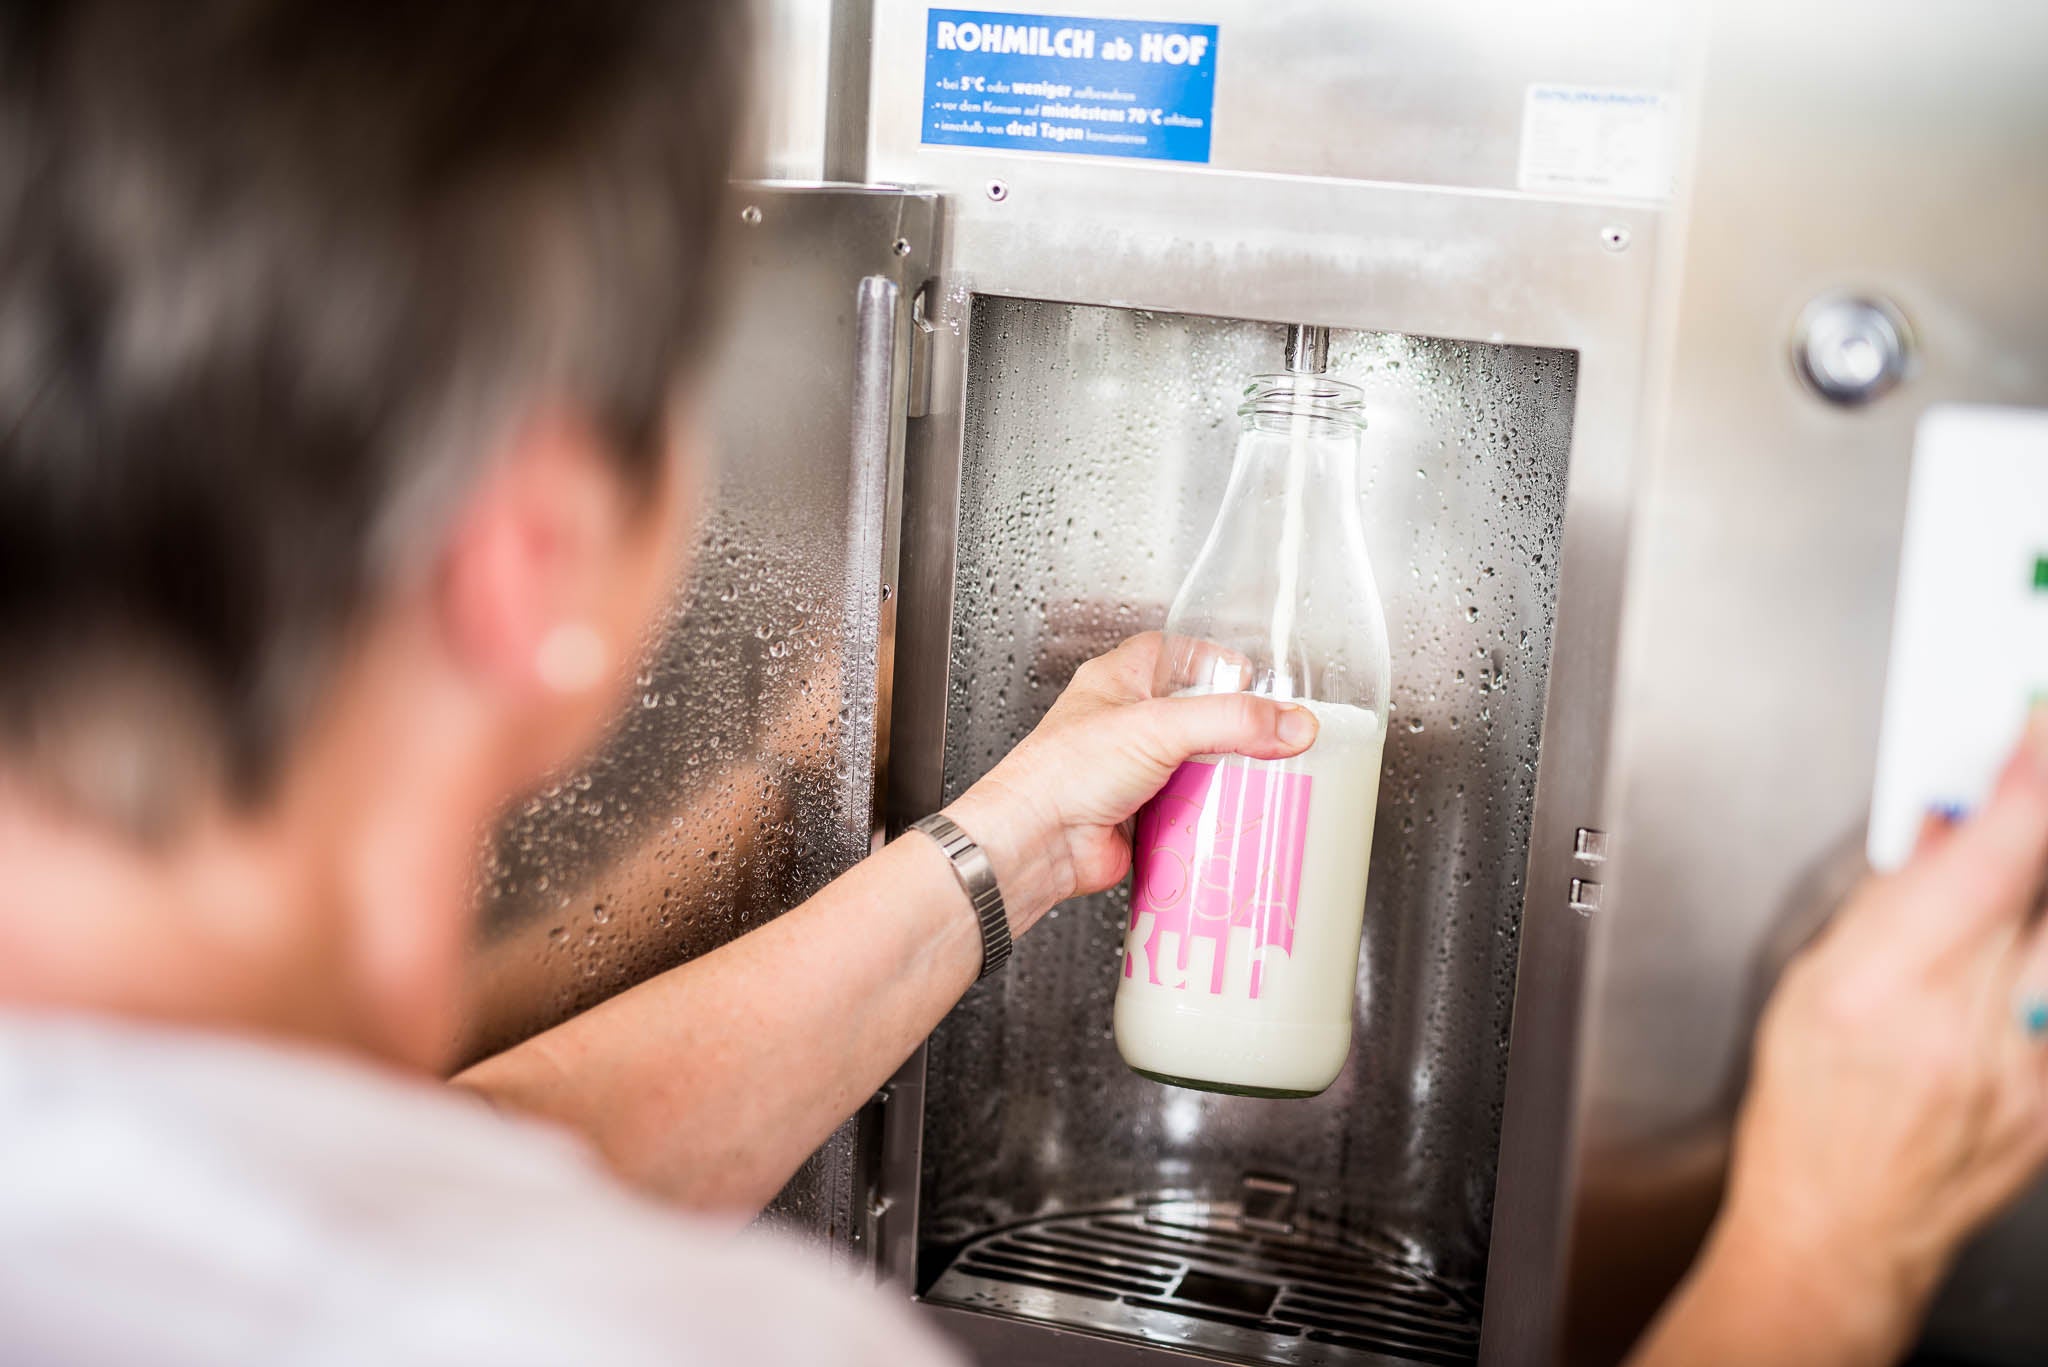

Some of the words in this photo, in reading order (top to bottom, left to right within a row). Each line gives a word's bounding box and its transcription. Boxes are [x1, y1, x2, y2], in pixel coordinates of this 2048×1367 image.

[937, 21, 1095, 59] ROHMILCH
[1101, 37, 1133, 61] ab
[1139, 33, 1209, 65] HOF
[943, 78, 959, 90] bei
[987, 80, 1010, 94] oder
[1012, 80, 1072, 99] weniger
[942, 102, 958, 112] vor
[959, 100, 981, 113] dem
[1040, 103, 1124, 122] mindestens
[1006, 121, 1037, 137] drei
[1040, 122, 1084, 142] Tagen
